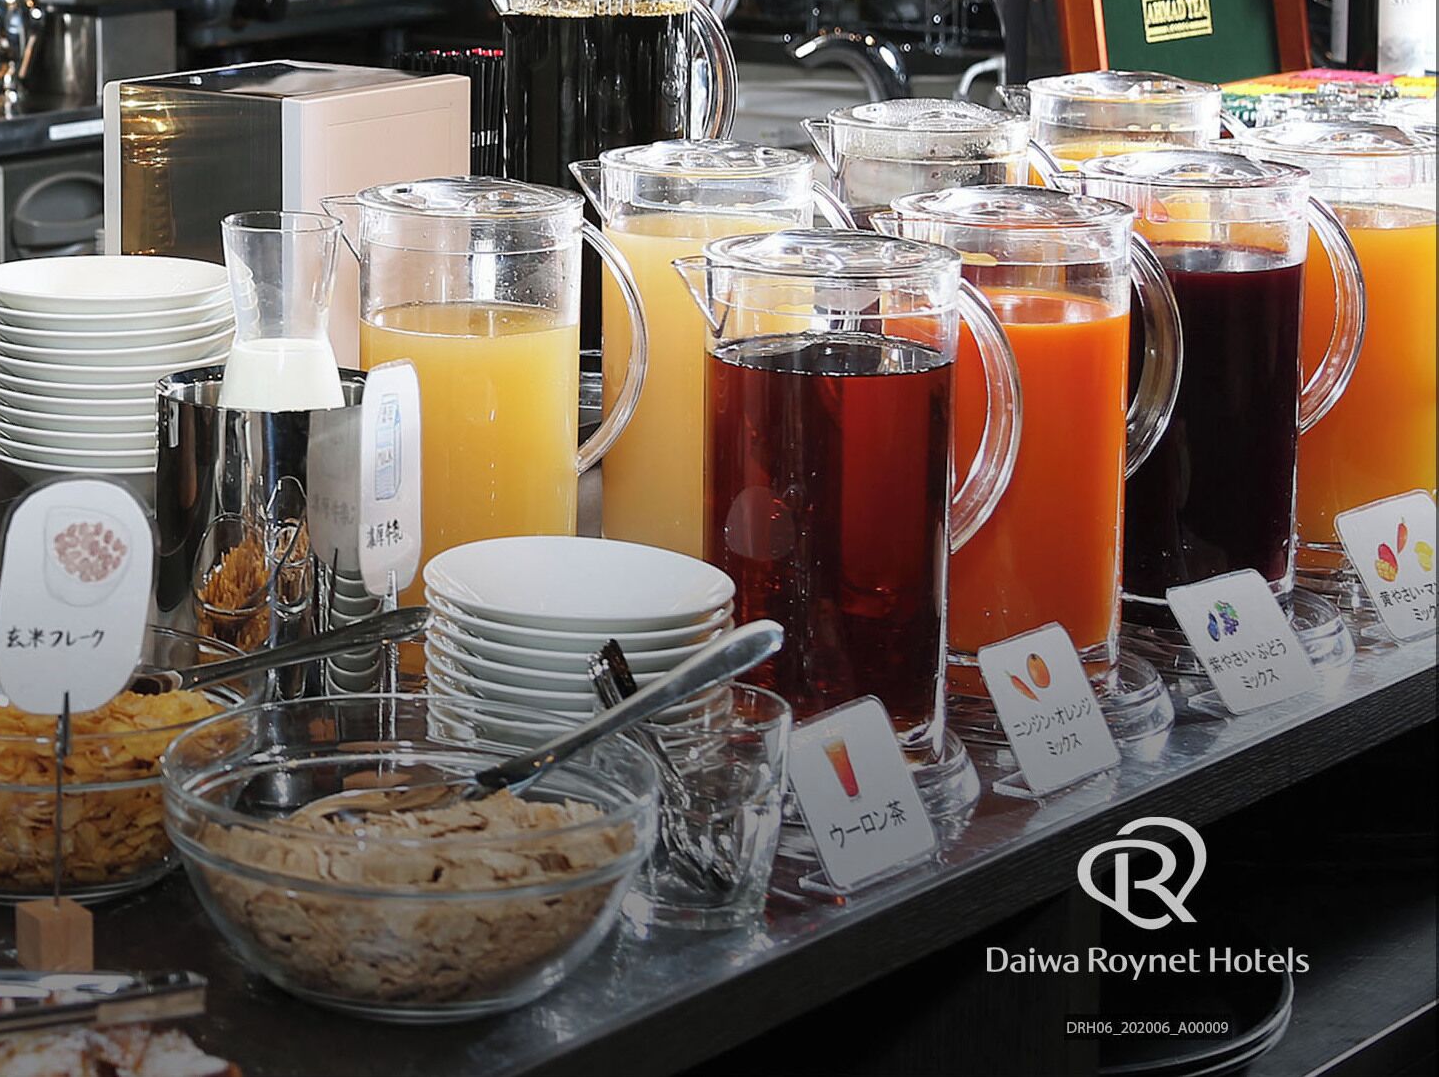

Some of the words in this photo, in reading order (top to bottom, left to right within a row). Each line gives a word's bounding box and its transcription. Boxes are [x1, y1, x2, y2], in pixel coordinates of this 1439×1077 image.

[6, 625, 106, 649] 玄米フレーク
[1209, 638, 1288, 674] 紫やさい・ぶどう
[1240, 669, 1281, 690] ミックス
[1013, 697, 1094, 738] ニンジン・オレンジ
[1046, 732, 1083, 756] ミックス
[828, 799, 907, 849] ウーロン茶
